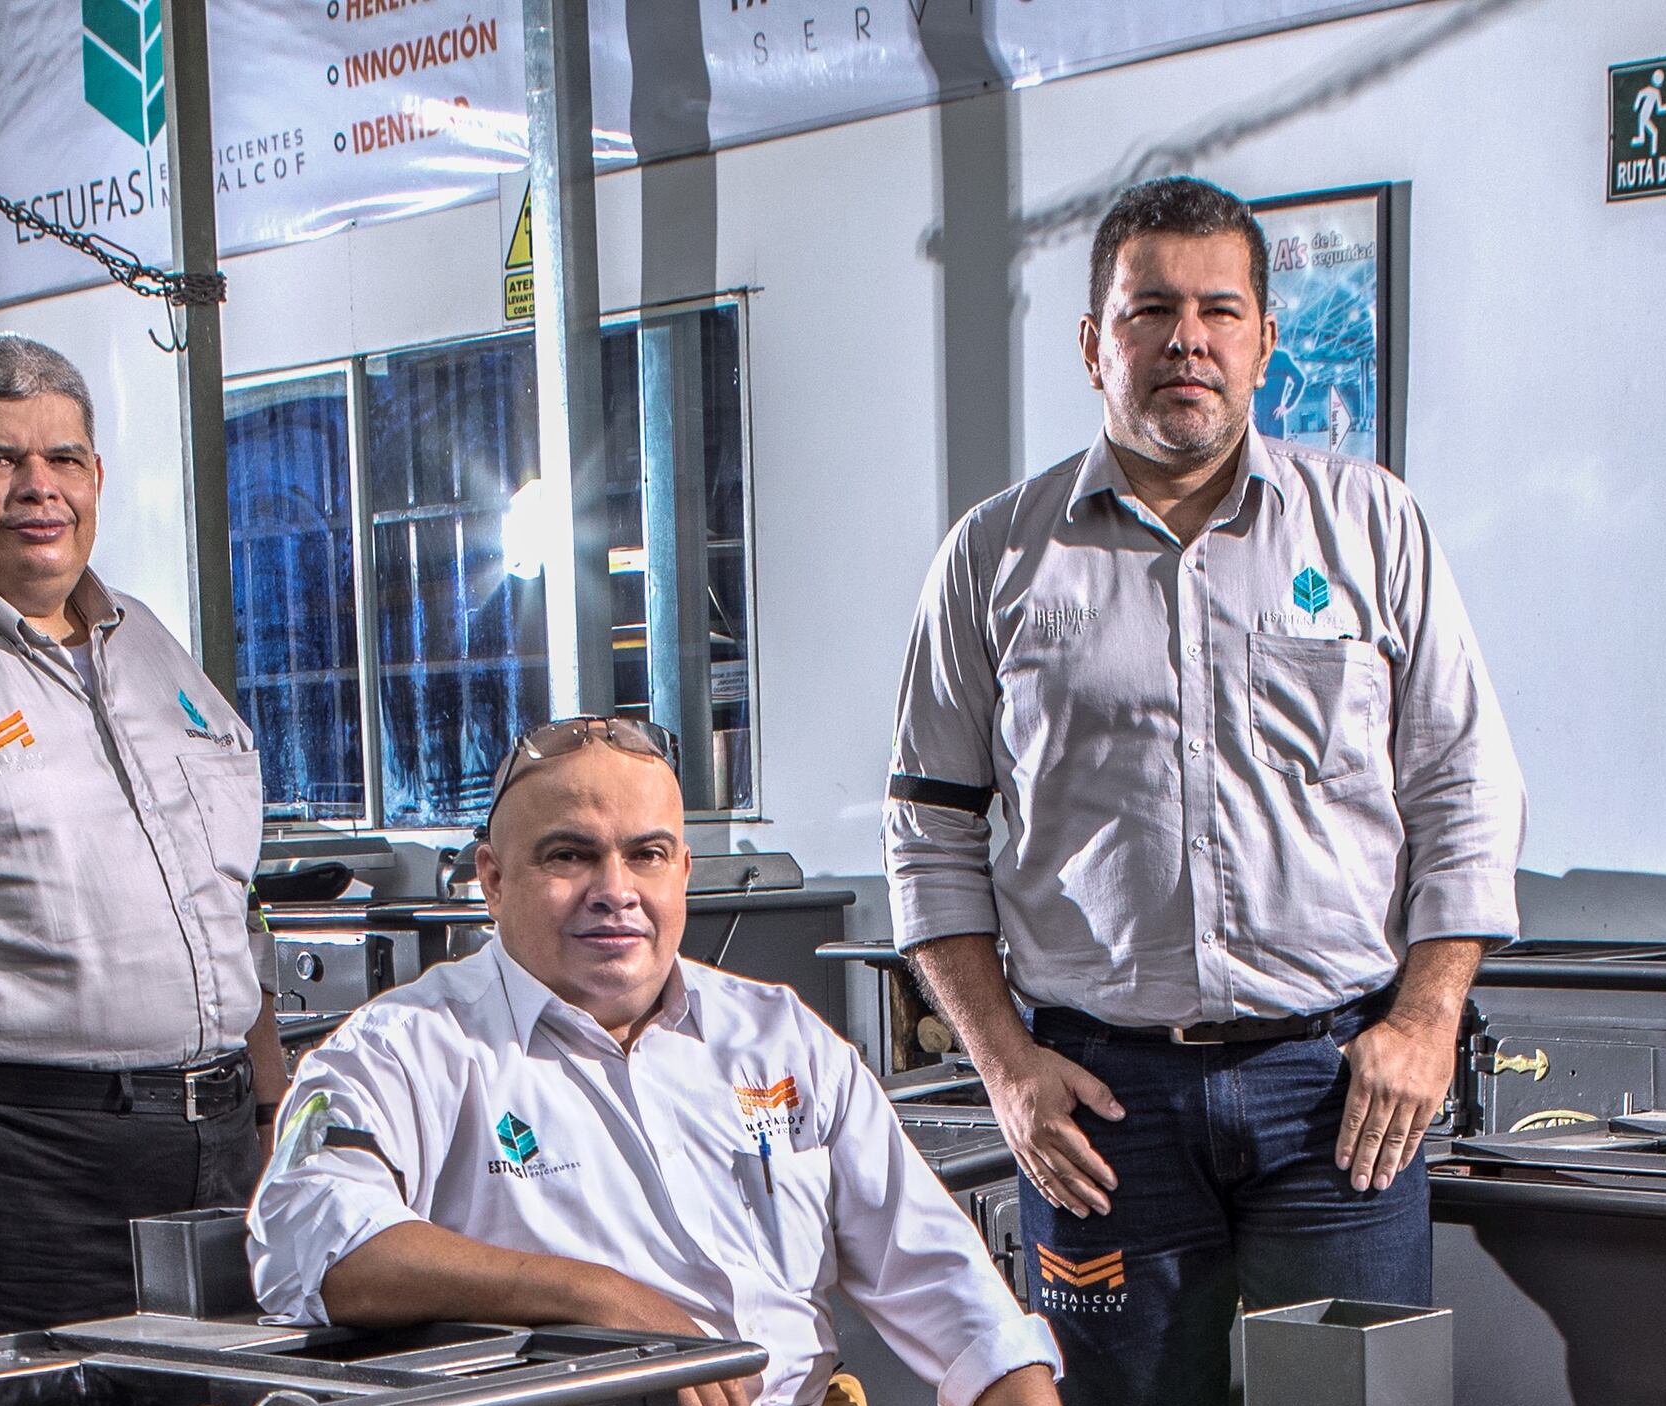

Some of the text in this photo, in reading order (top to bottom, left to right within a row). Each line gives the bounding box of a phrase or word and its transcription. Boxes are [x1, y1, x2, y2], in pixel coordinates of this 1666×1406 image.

[345, 14, 498, 88] INNOVACIÓN
[351, 95, 470, 154] IDENT
[1616, 157, 1655, 191] RUTA
[15, 169, 145, 244] ESTUFAS
[1311, 230, 1343, 250] de la
[1311, 241, 1376, 269] seguridad
[509, 278, 534, 293] ATEN
[514, 305, 528, 315] CON
[1035, 607, 1100, 627] HERMES
[1041, 1287, 1129, 1304] METALCOF
